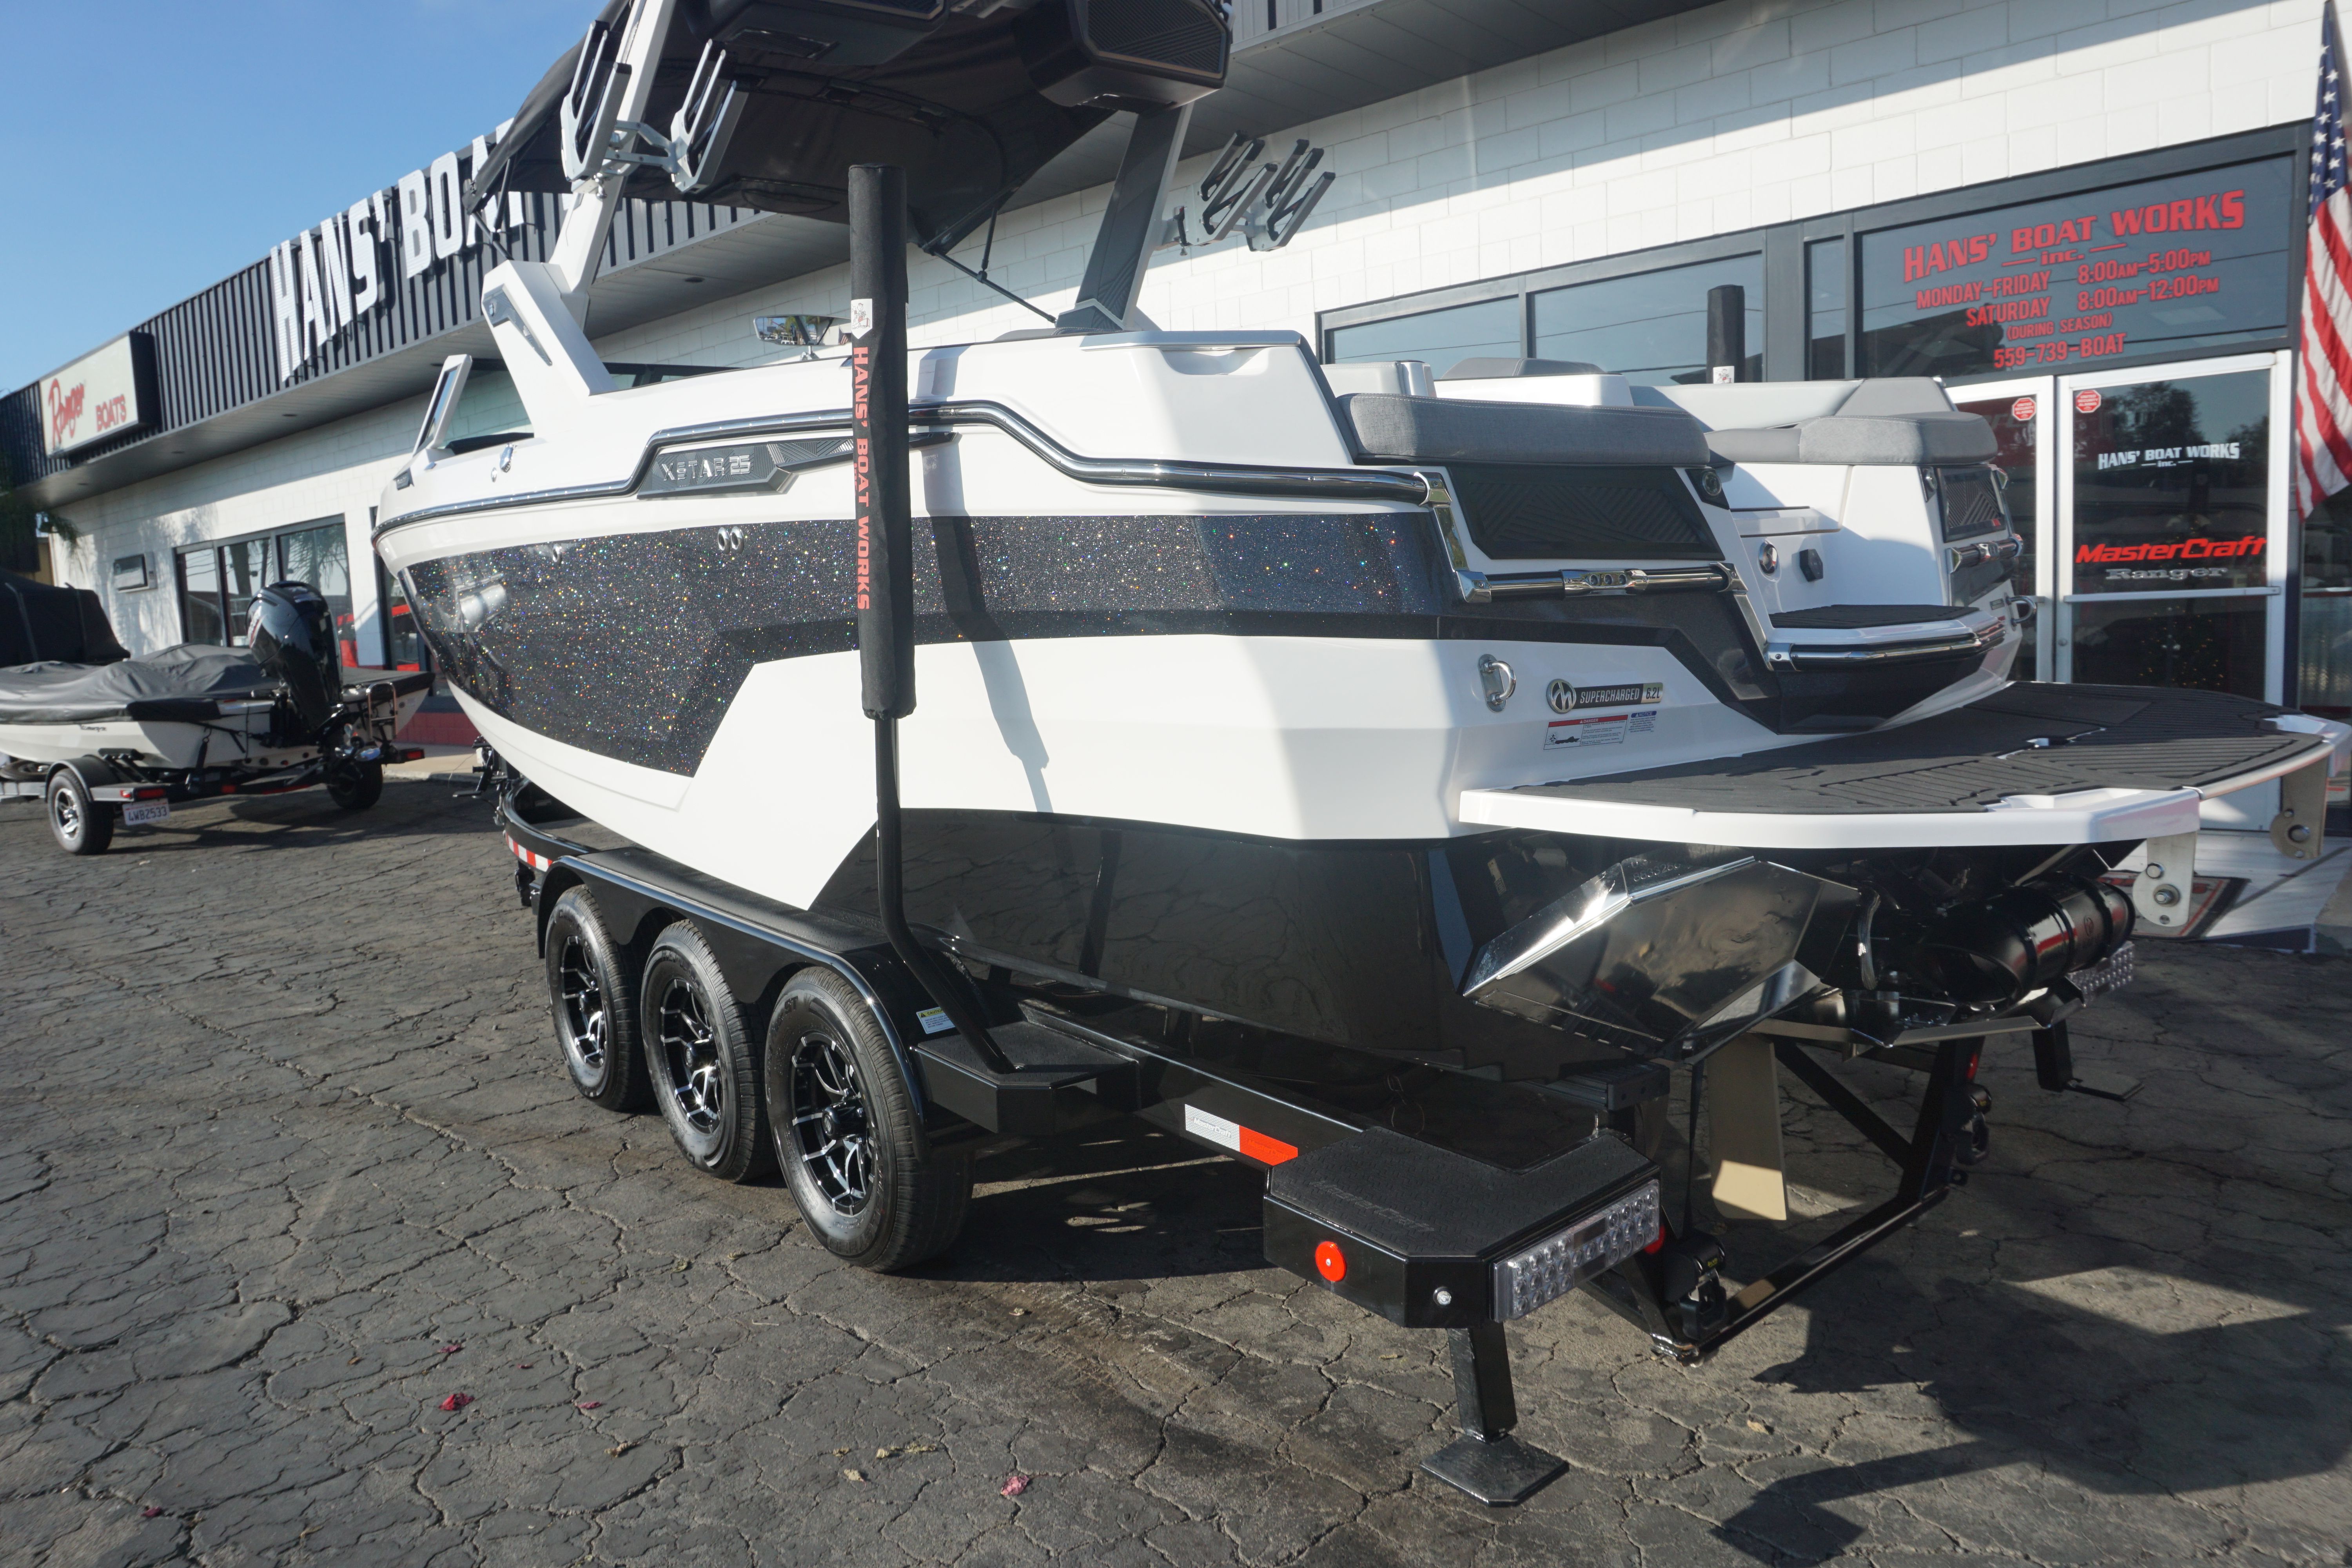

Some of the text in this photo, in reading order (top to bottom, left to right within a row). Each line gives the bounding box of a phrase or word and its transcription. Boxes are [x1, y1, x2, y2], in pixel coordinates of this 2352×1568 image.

[1904, 189, 2245, 283] HANS' BOAT WORKS
[2041, 247, 2085, 265] inc.
[270, 189, 387, 382] HANS'
[1916, 249, 2211, 309] MONDAY-FRIDAY 8:00AM-5:00PM
[1966, 275, 2219, 327] SATURDAY 8:00AM-12:00PM
[2007, 312, 2113, 341] (DURING SEASON)
[1994, 333, 2126, 368] 559-739-BOAT
[48, 378, 84, 451] Ranger
[96, 394, 126, 432] BOATS
[730, 455, 751, 475] 25
[2098, 442, 2240, 470] HANS' BOAT WORKS
[853, 347, 869, 610] HANS' BOAT WORKS
[2075, 535, 2267, 563] MasterCraft
[2105, 567, 2227, 581] Ranger
[1580, 687, 1660, 704] SUPERCHARGED 6.2L
[1193, 1117, 1231, 1138] MasterCraft
